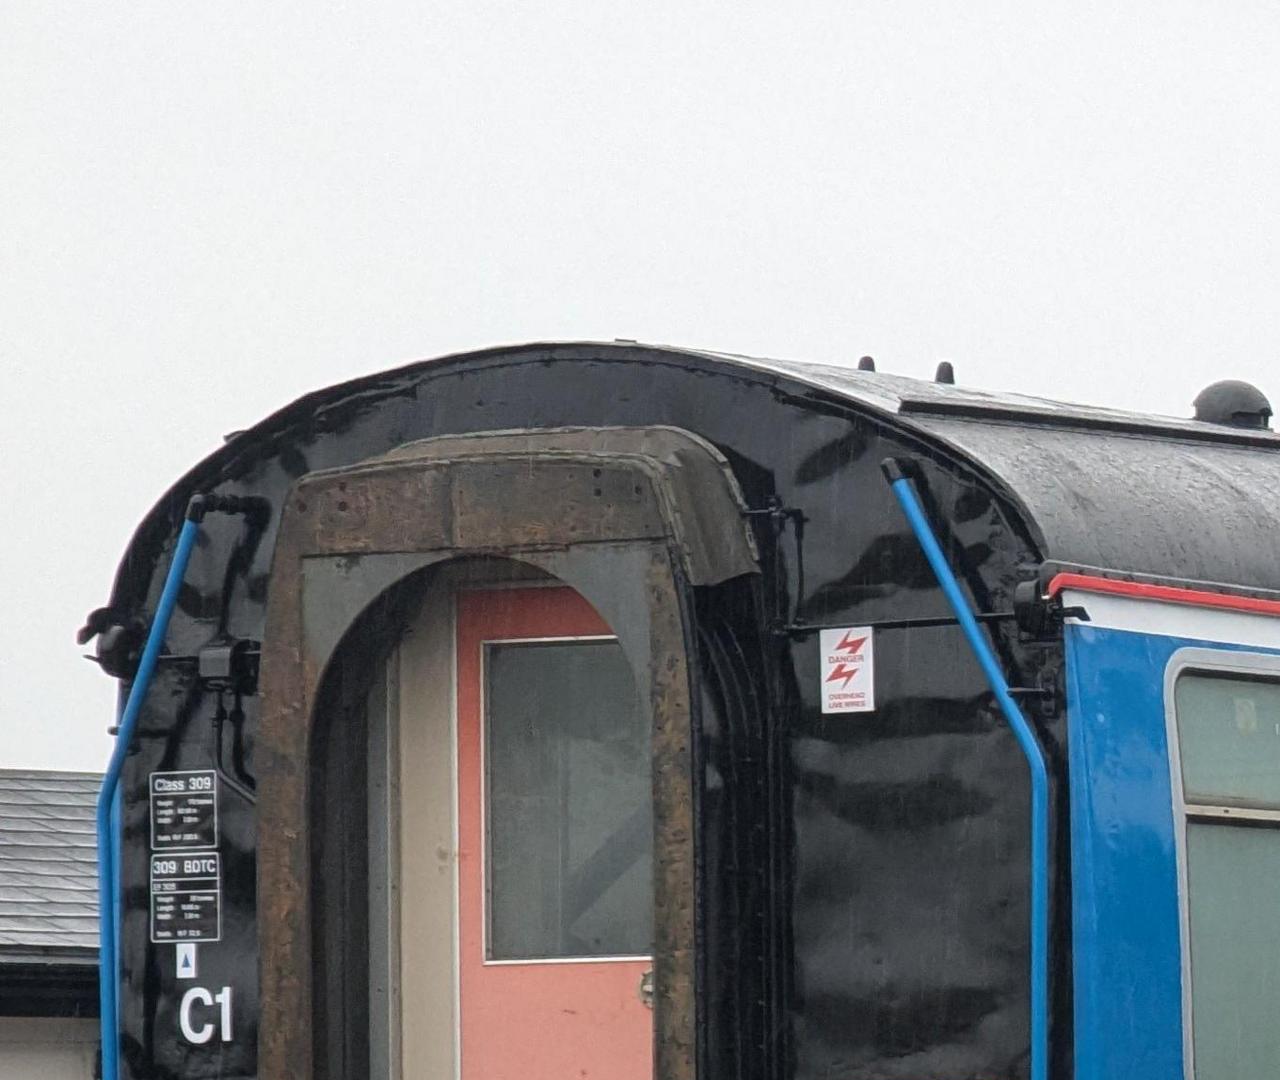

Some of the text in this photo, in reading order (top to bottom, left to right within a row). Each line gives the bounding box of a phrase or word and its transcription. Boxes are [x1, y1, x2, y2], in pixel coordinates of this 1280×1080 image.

[828, 655, 865, 664] DANGER
[154, 776, 211, 791] Class 309
[153, 859, 216, 874] 309 BDTC
[180, 986, 232, 1045] C1
